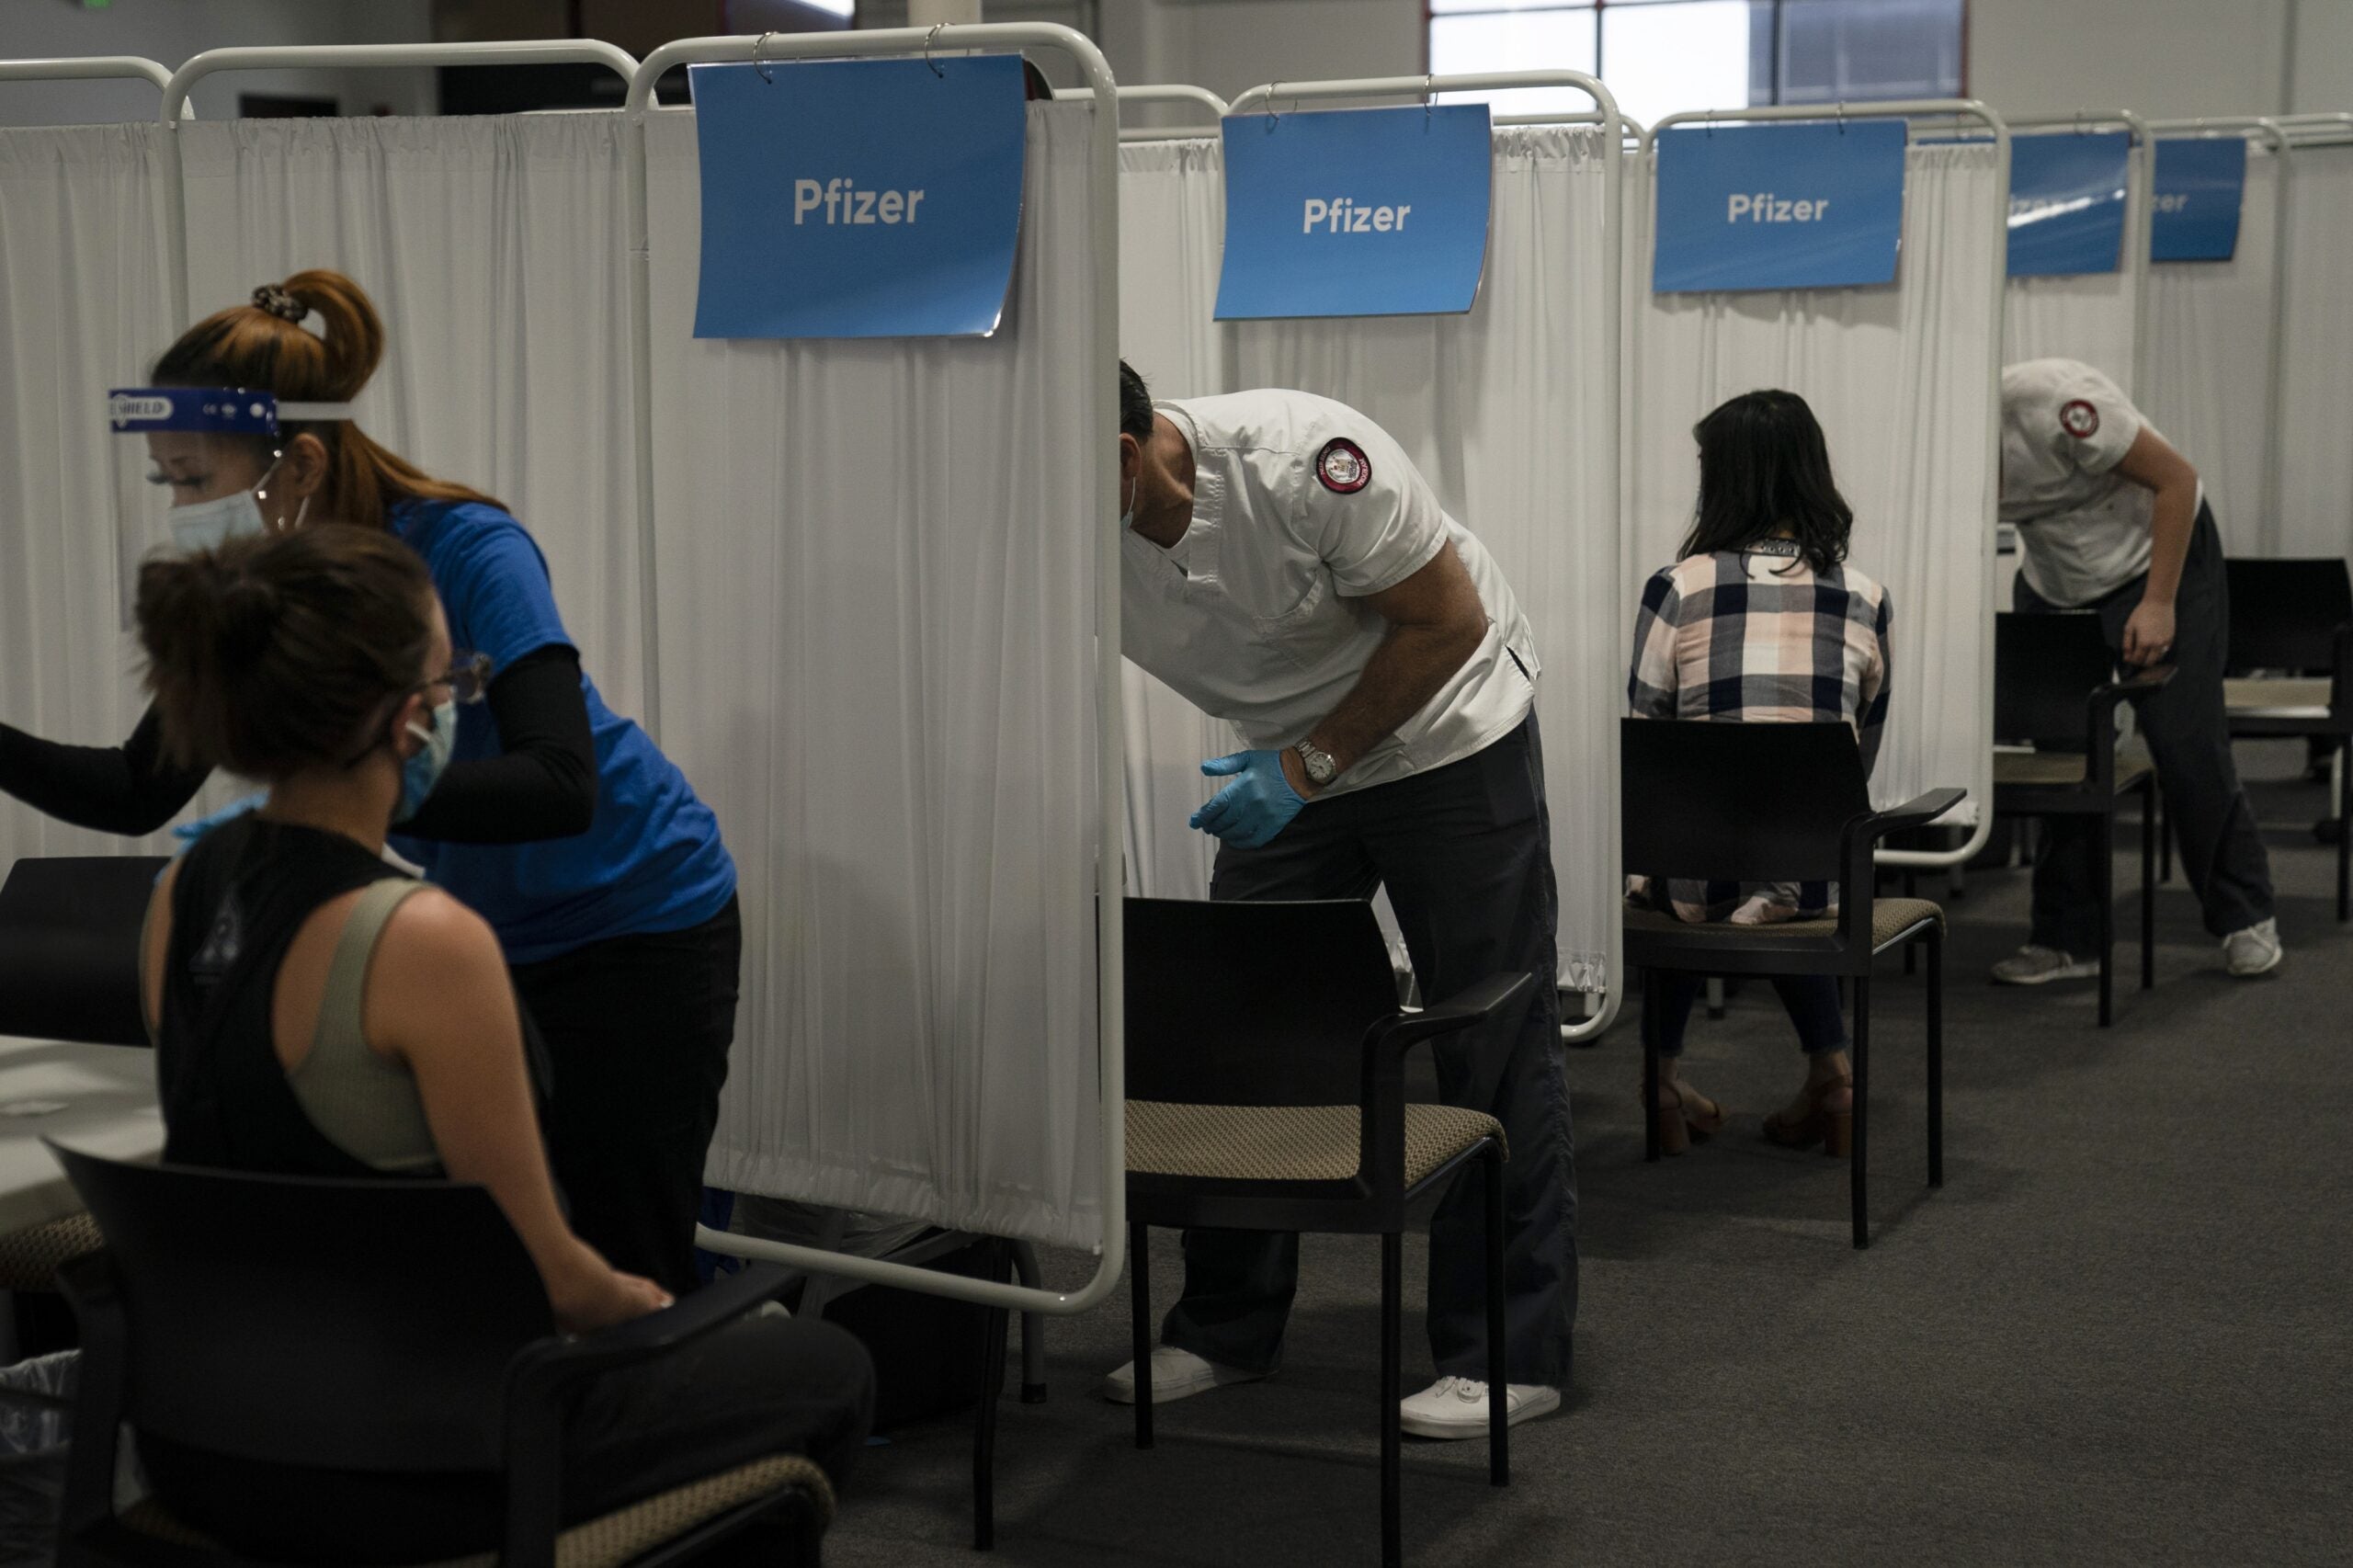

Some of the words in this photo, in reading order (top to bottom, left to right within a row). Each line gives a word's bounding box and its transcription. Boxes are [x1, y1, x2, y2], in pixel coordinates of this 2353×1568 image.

[794, 177, 924, 225] Pfizer
[1303, 198, 1411, 234] Pfizer
[1728, 193, 1829, 223] Pfizer
[116, 402, 165, 415] SHIELD
